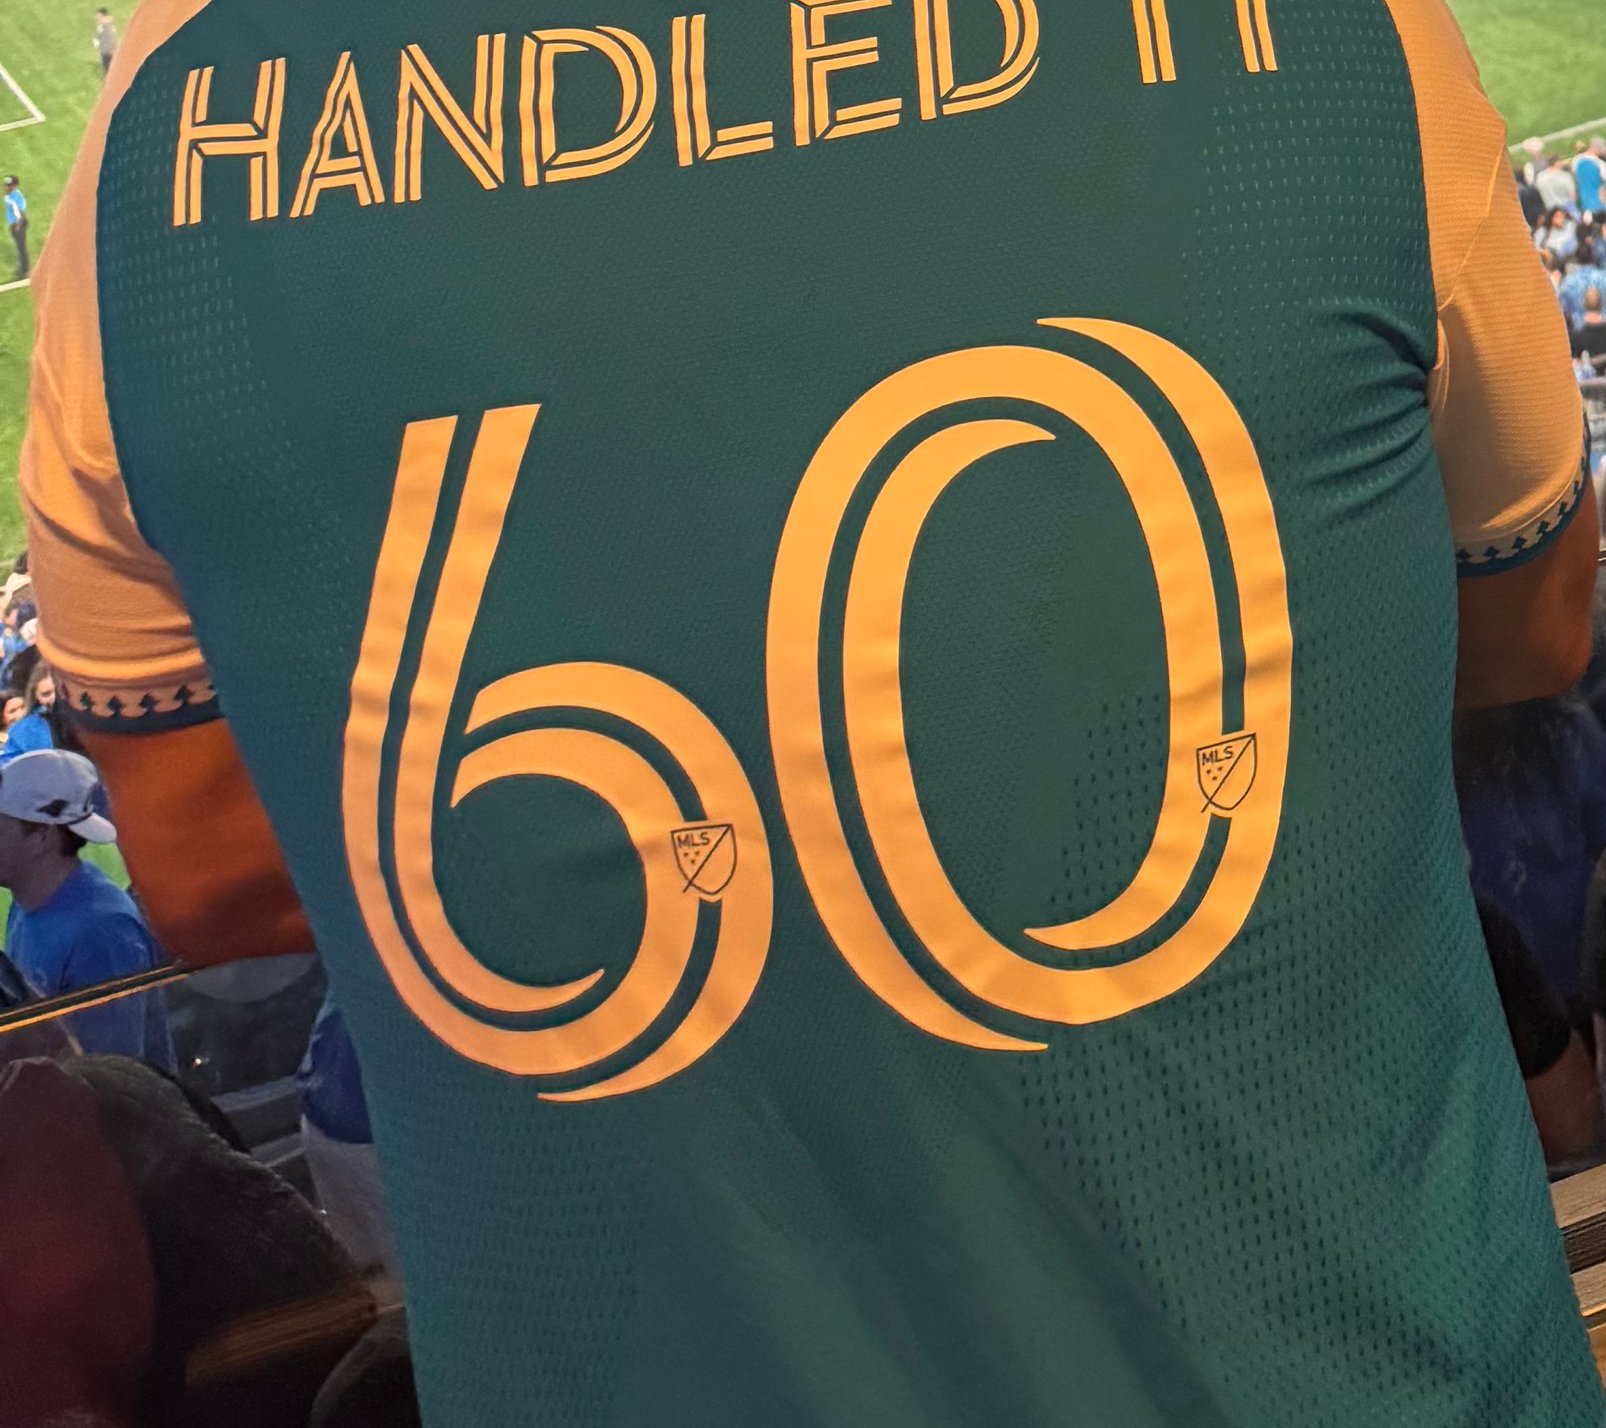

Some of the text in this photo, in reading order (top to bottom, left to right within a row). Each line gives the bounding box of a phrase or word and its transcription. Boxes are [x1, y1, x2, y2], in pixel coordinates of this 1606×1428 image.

[342, 316, 1293, 1102] 60
[1202, 746, 1234, 766] MLS
[677, 831, 710, 848] MLS
